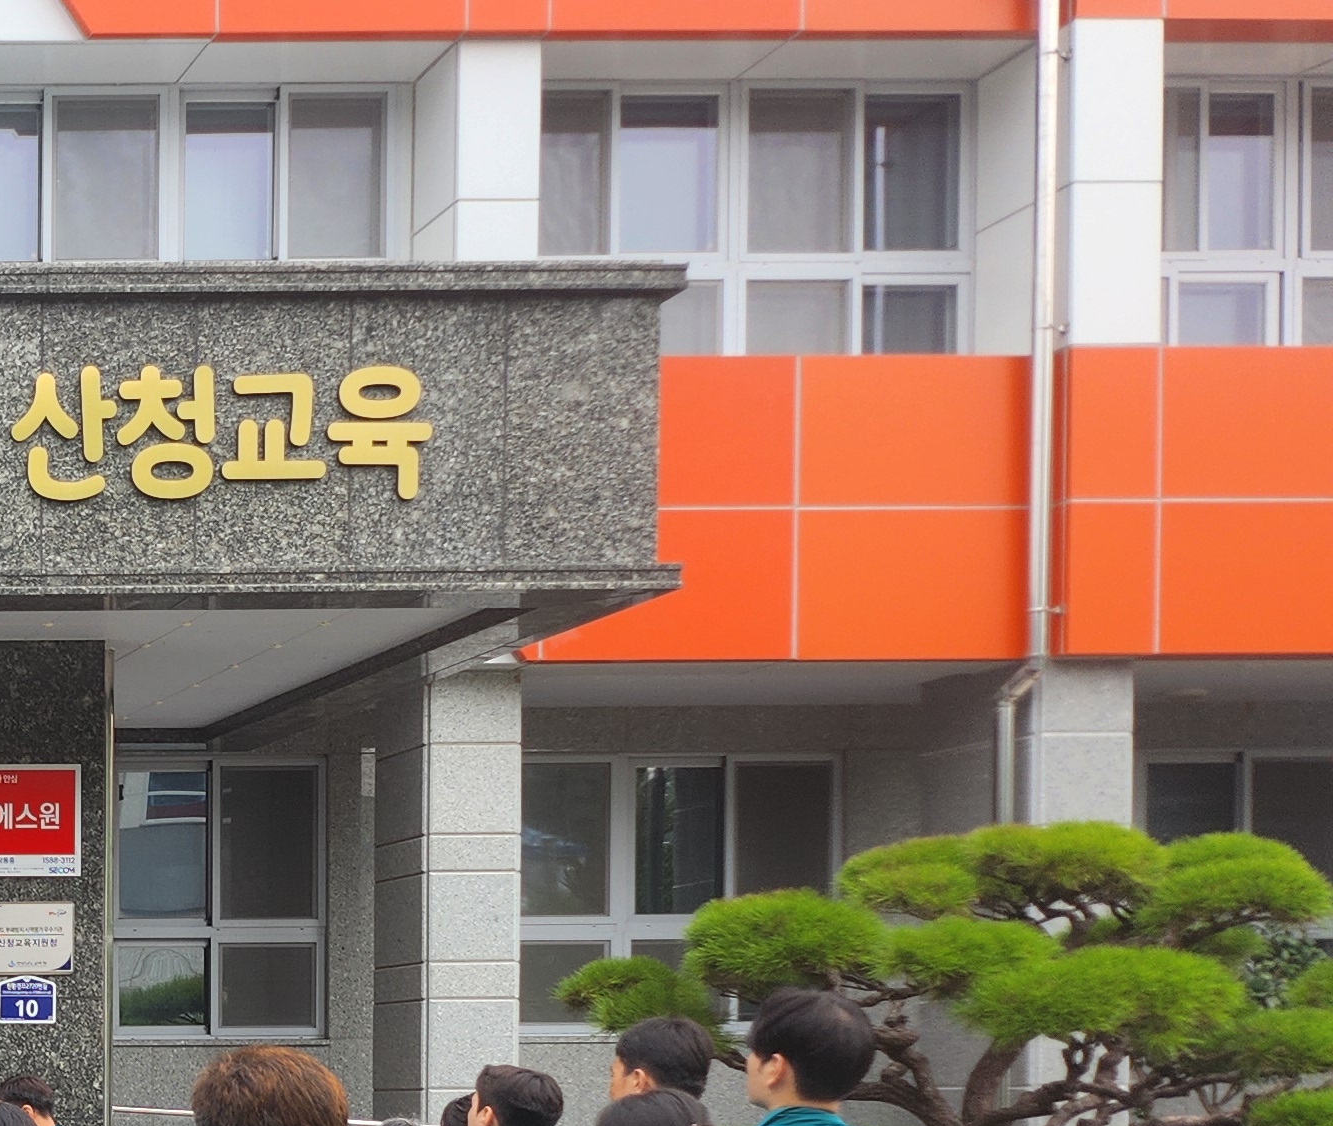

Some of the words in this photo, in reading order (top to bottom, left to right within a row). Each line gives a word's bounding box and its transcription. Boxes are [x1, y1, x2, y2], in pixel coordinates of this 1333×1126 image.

[12, 365, 433, 500] 산청교육
[3, 774, 18, 784] 안심
[15, 999, 39, 1017] 10
